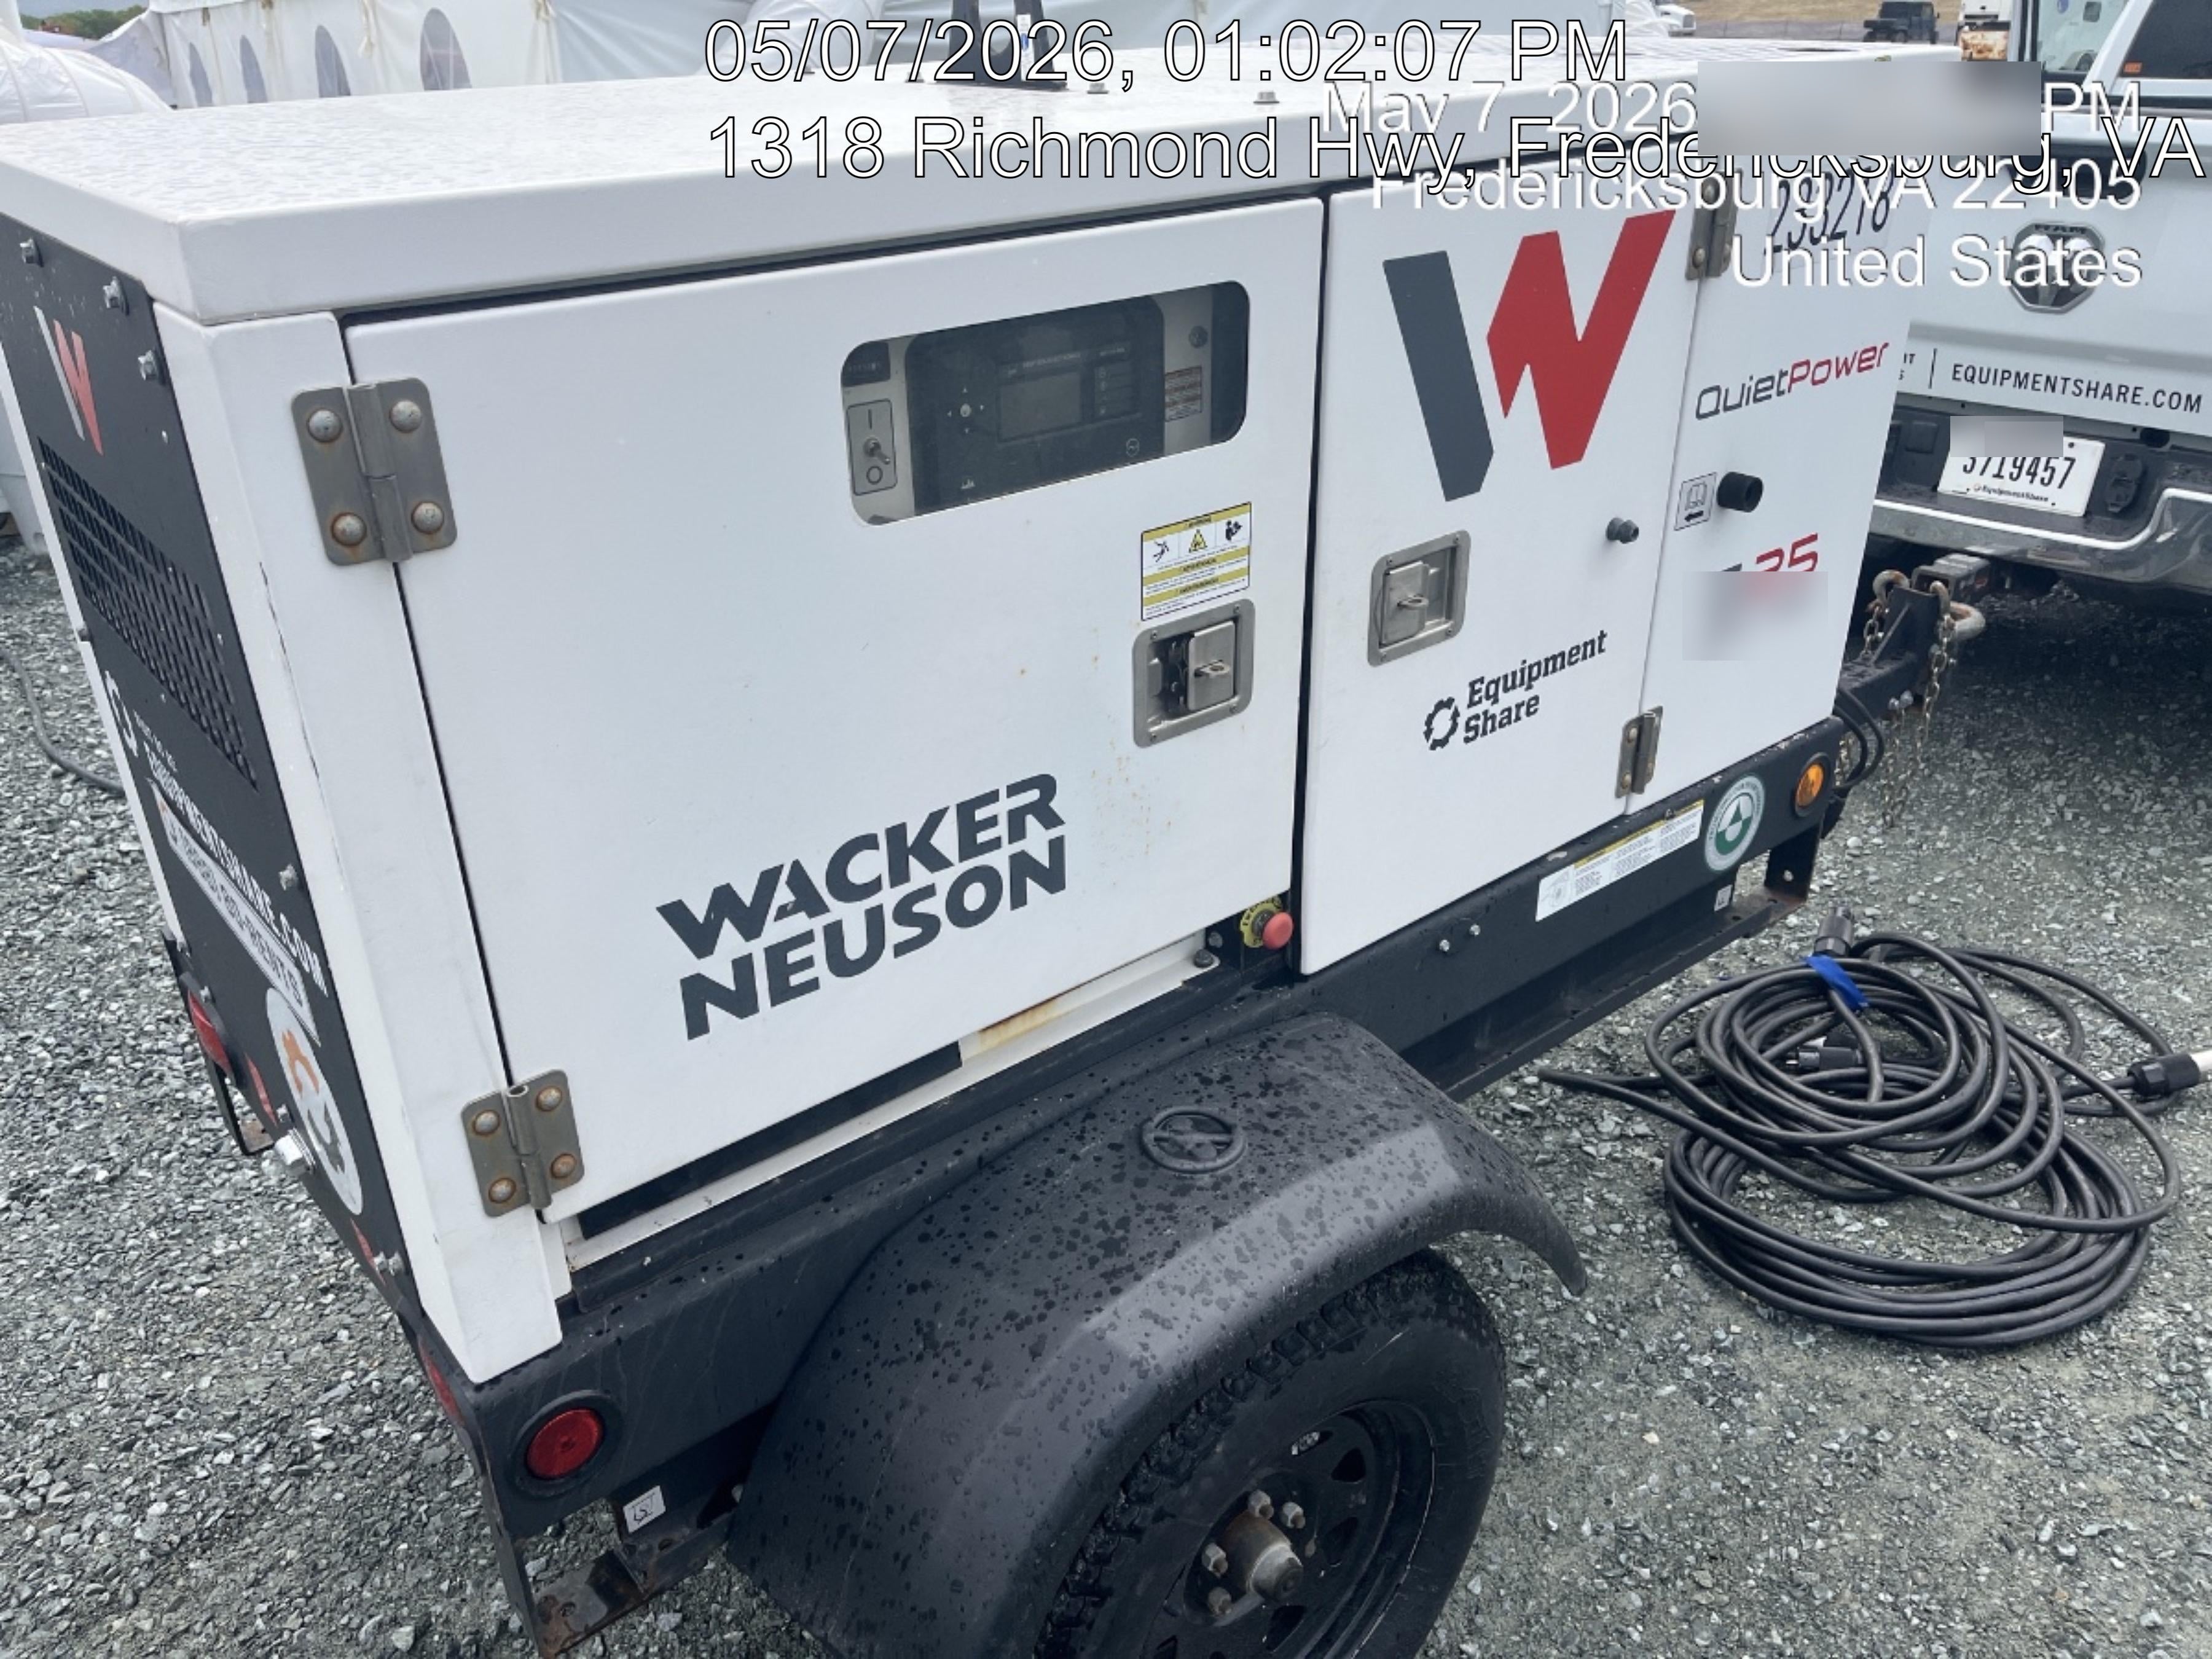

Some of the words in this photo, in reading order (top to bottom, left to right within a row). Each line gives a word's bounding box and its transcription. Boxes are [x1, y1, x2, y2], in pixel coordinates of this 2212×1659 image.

[1695, 342, 1890, 420] QuietPower
[1951, 363, 2203, 414] EQUIPMENTSHARE.COM
[1467, 630, 1608, 708] Equipment
[1463, 695, 1540, 744] Share
[656, 773, 1066, 960] WACKER
[679, 834, 1067, 1041] NEUSON
